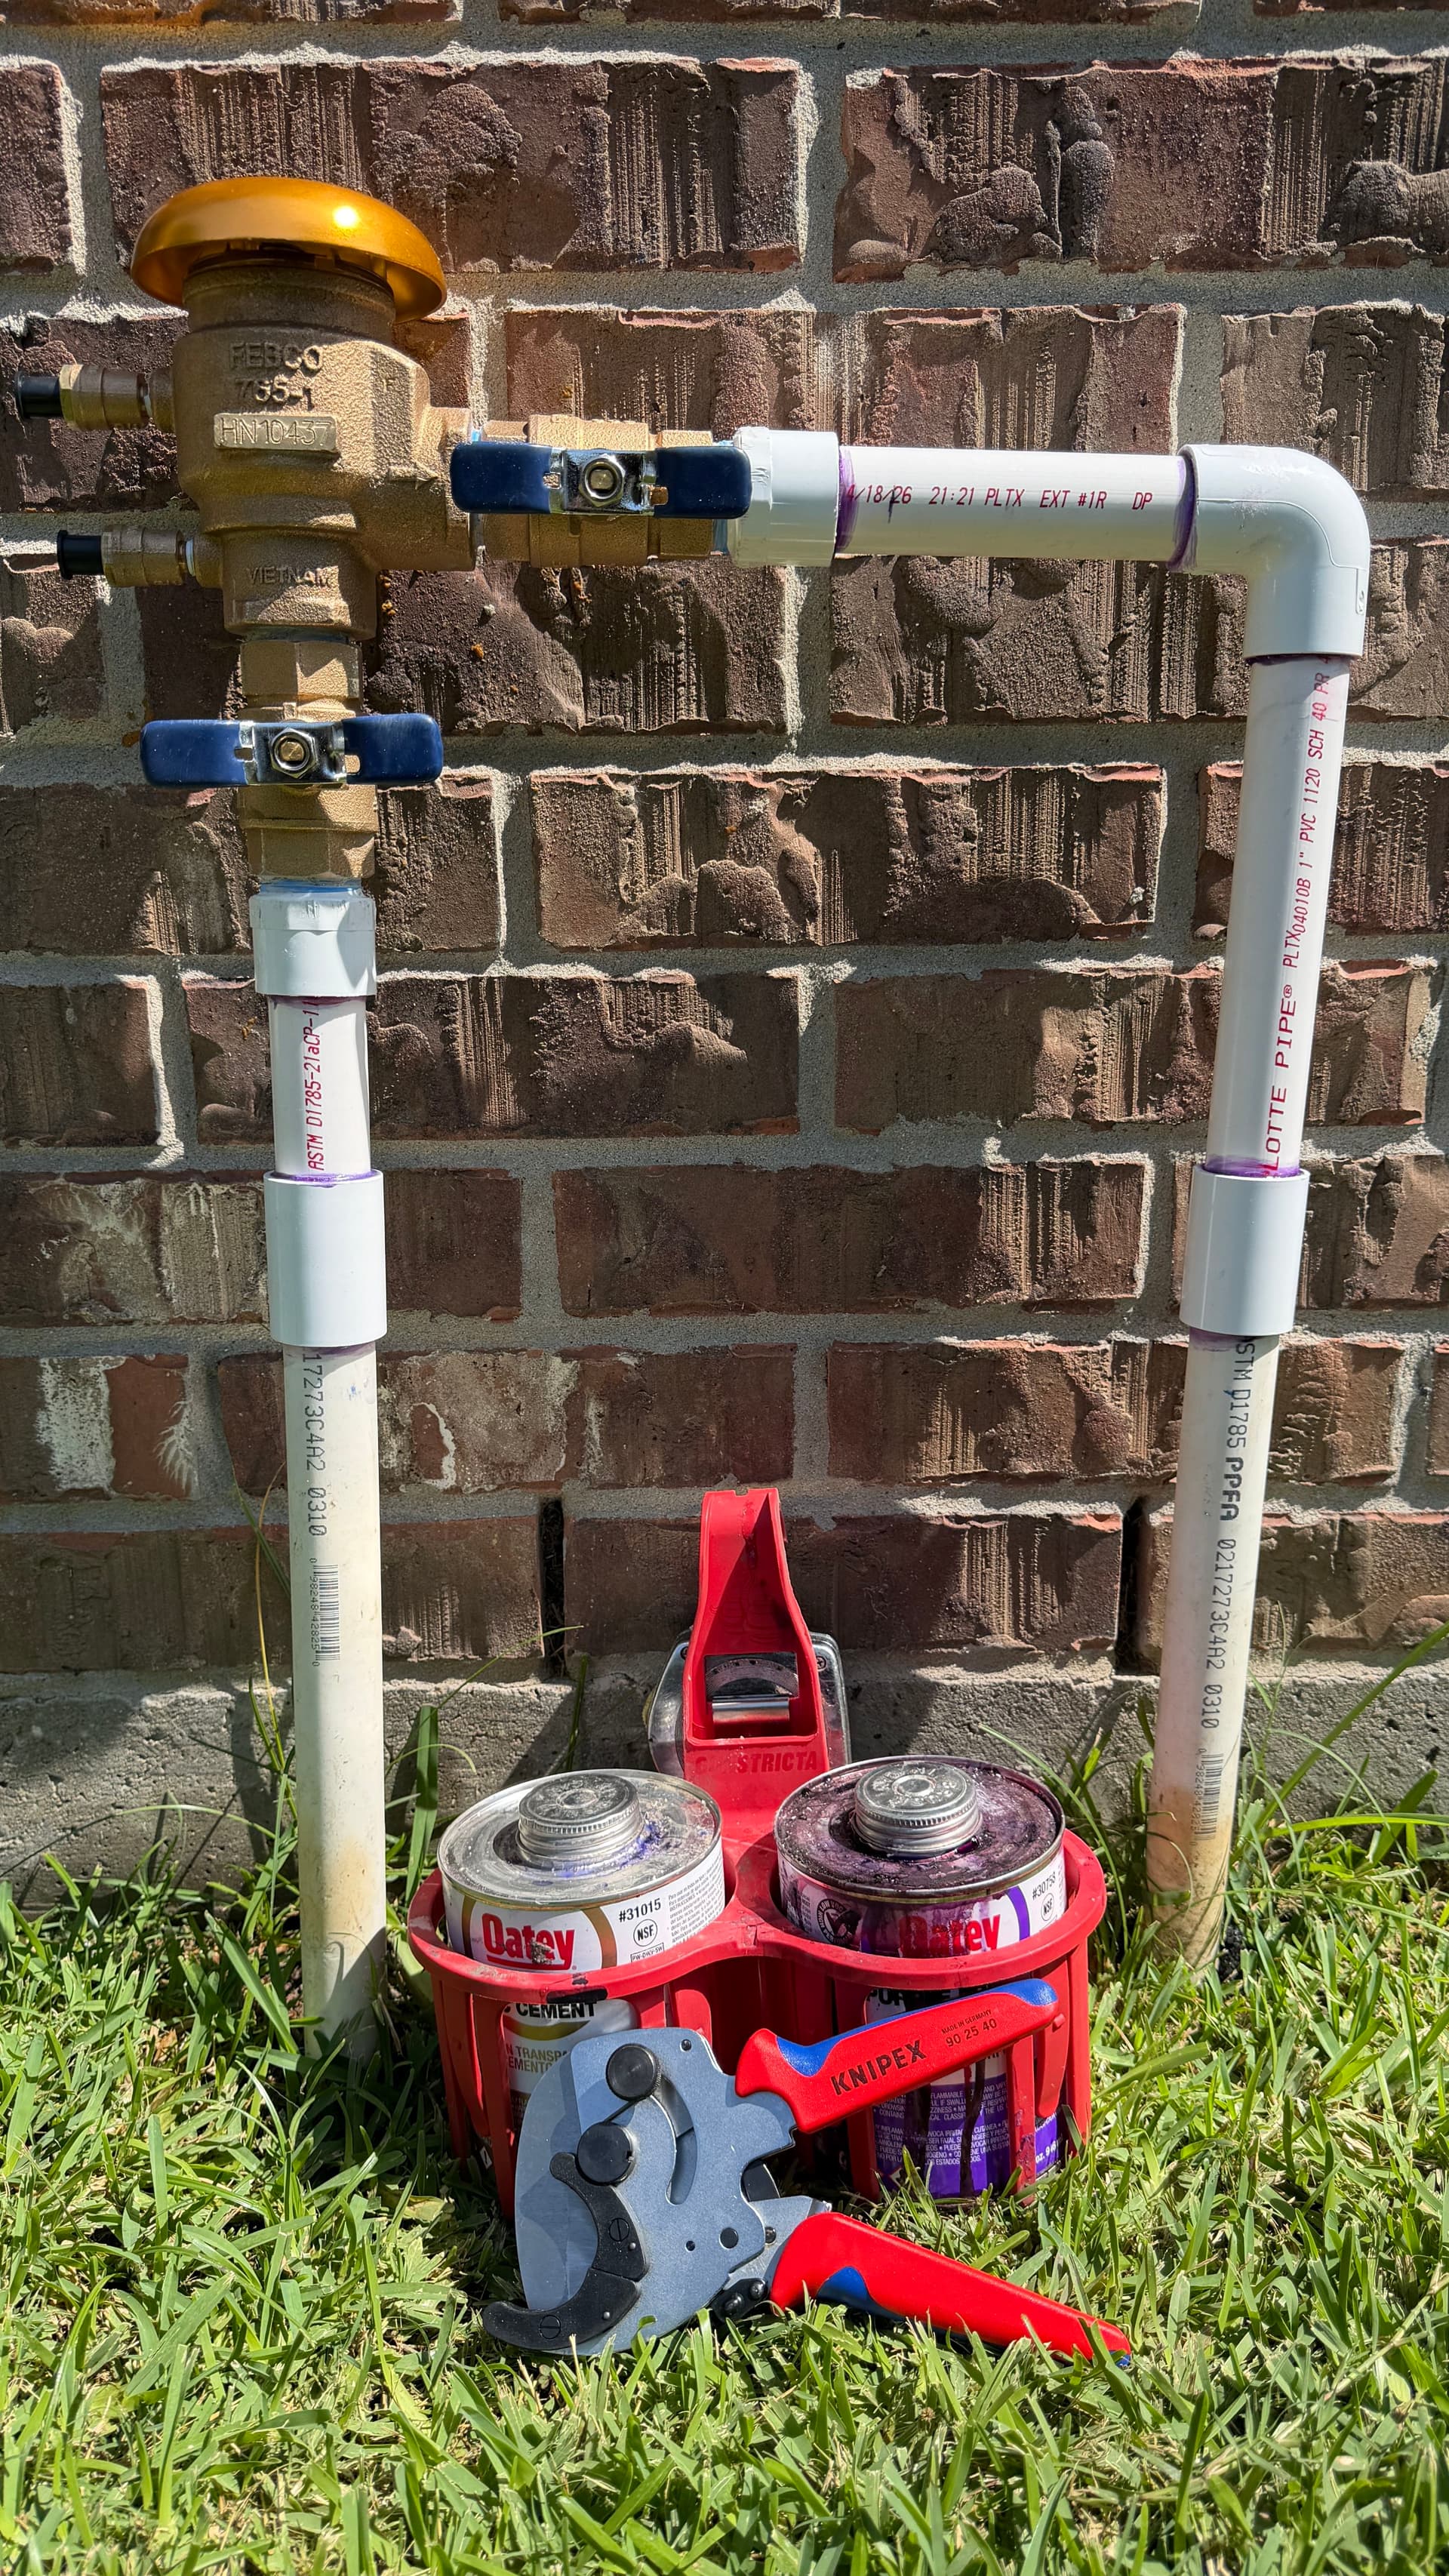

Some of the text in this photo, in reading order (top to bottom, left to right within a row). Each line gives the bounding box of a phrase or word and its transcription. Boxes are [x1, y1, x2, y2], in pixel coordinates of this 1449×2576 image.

[230, 343, 323, 372] FEBCO
[220, 417, 332, 447] HN10437
[846, 485, 1153, 511] 4/18/26 21:21 PLTX EXT #1R DP
[246, 566, 332, 587] VIETNAM
[1312, 702, 1327, 722] 40
[1308, 729, 1324, 759] SCH
[1303, 768, 1321, 804] 1120
[1300, 813, 1316, 843] PVC
[1299, 852, 1312, 869] 1"
[1283, 878, 1311, 968] PLTX04010B
[1260, 1085, 1287, 1171] LOTTE
[308, 1134, 325, 1171] ASTM
[302, 1353, 328, 1537] 17273C4A2 0310
[1201, 1342, 1256, 1729] STM D1785 PPFA 0217273C4A2 0310
[737, 1751, 817, 1774] STRICTA
[619, 1897, 662, 1923] #31015
[481, 1913, 575, 1971] Oatey
[637, 1924, 654, 1941] NSF
[515, 2001, 597, 2019] CEMENT
[941, 2008, 992, 2035] MADE IN GERMANY
[946, 2018, 998, 2047] 90 25 40
[506, 2043, 514, 2055] N
[508, 2057, 552, 2073] EMENTO
[831, 2039, 927, 2096] KNIPEX
